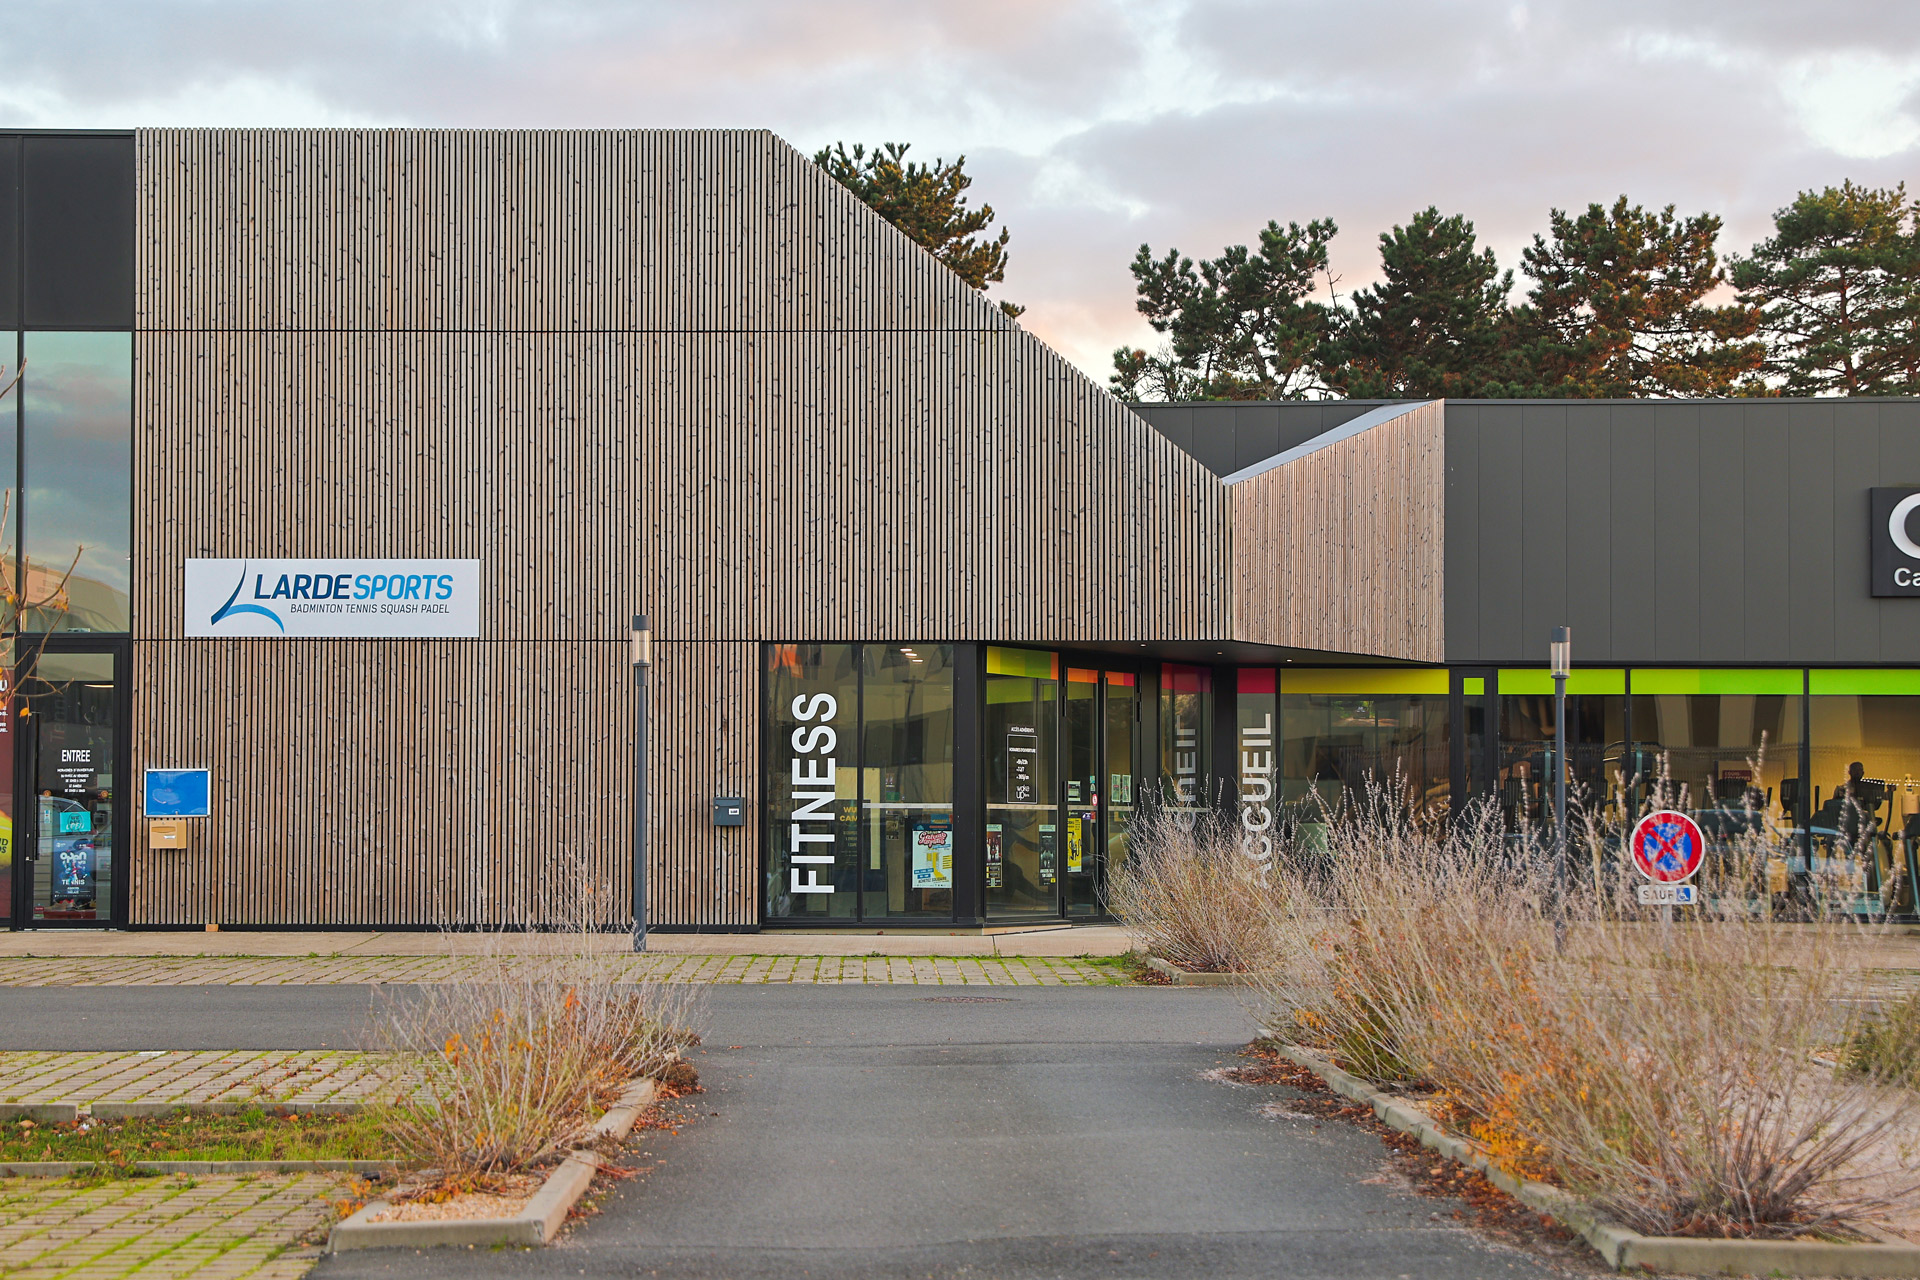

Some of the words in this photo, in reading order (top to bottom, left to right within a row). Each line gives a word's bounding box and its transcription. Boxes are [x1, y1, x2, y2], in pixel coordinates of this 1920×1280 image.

[290, 603, 343, 614] BADMINTON
[345, 603, 378, 614] TENNIS
[380, 603, 418, 615] SQUASH
[420, 603, 450, 614] PADEL
[61, 749, 91, 762] ENTREE
[790, 693, 837, 894] FITNESS
